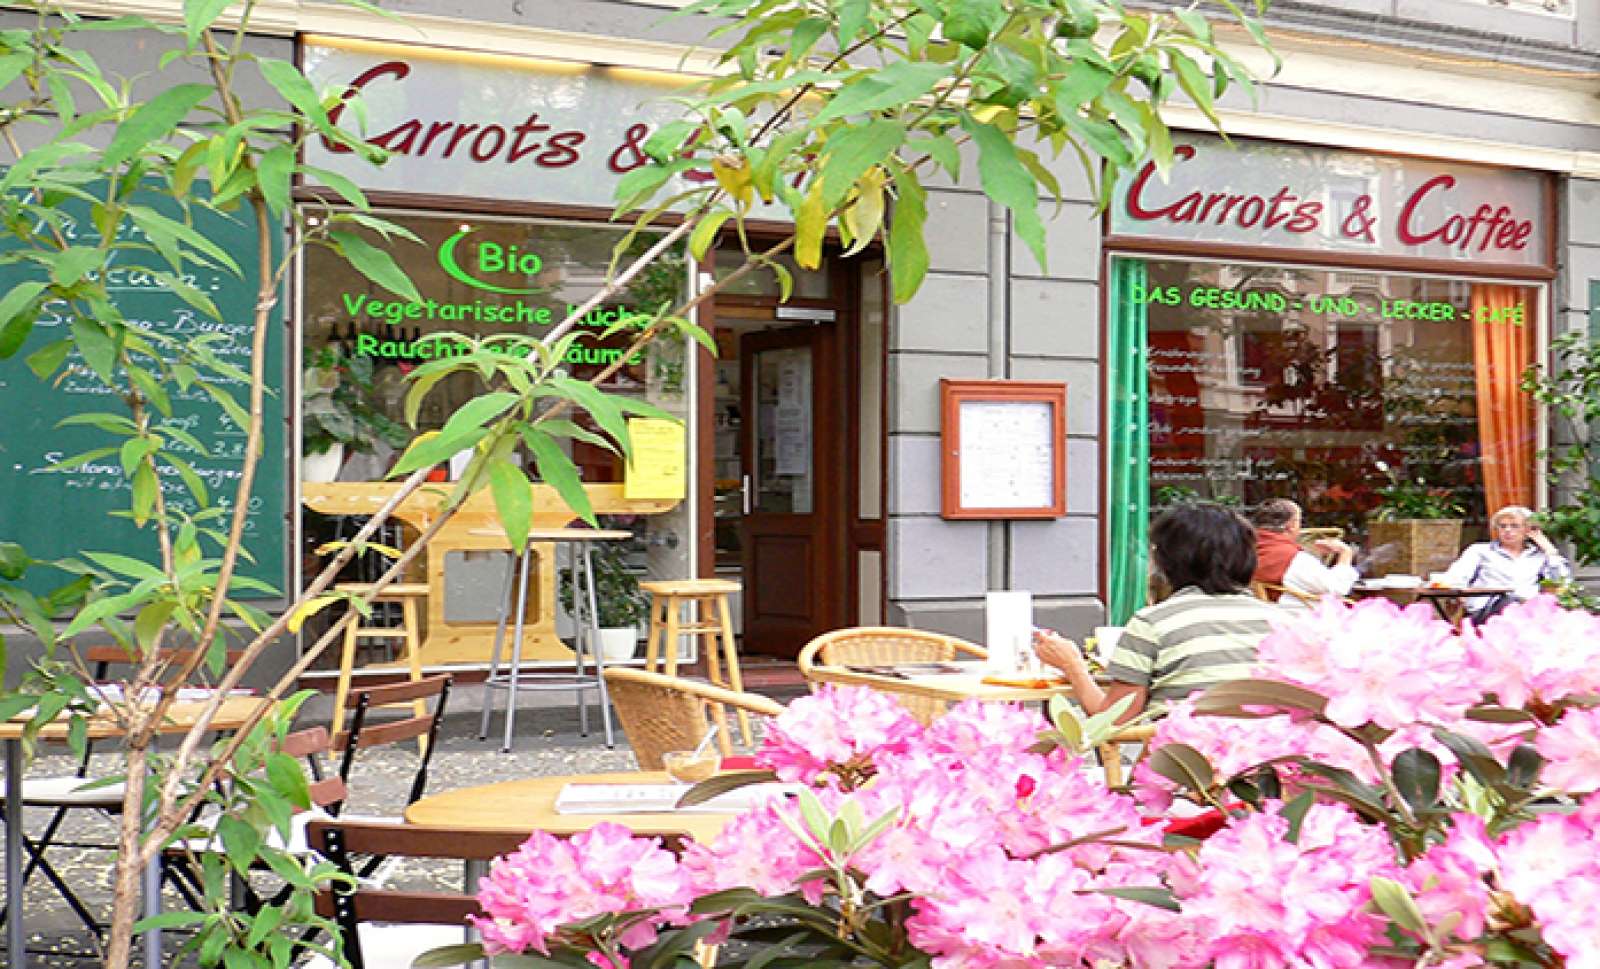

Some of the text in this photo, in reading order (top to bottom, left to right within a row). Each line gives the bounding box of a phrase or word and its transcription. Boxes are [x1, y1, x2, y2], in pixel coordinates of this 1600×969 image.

[320, 61, 586, 169] Carrots
[609, 122, 649, 174] &
[1126, 144, 1533, 251] Carrots & Coffee
[478, 241, 543, 275] Bio
[342, 293, 553, 324] Vegetarische
[1129, 283, 1182, 305] DAS
[1190, 288, 1286, 312] GESUND
[1310, 298, 1357, 316] UND
[1381, 300, 1455, 320] LECKER
[1475, 302, 1525, 325] CAFÉ
